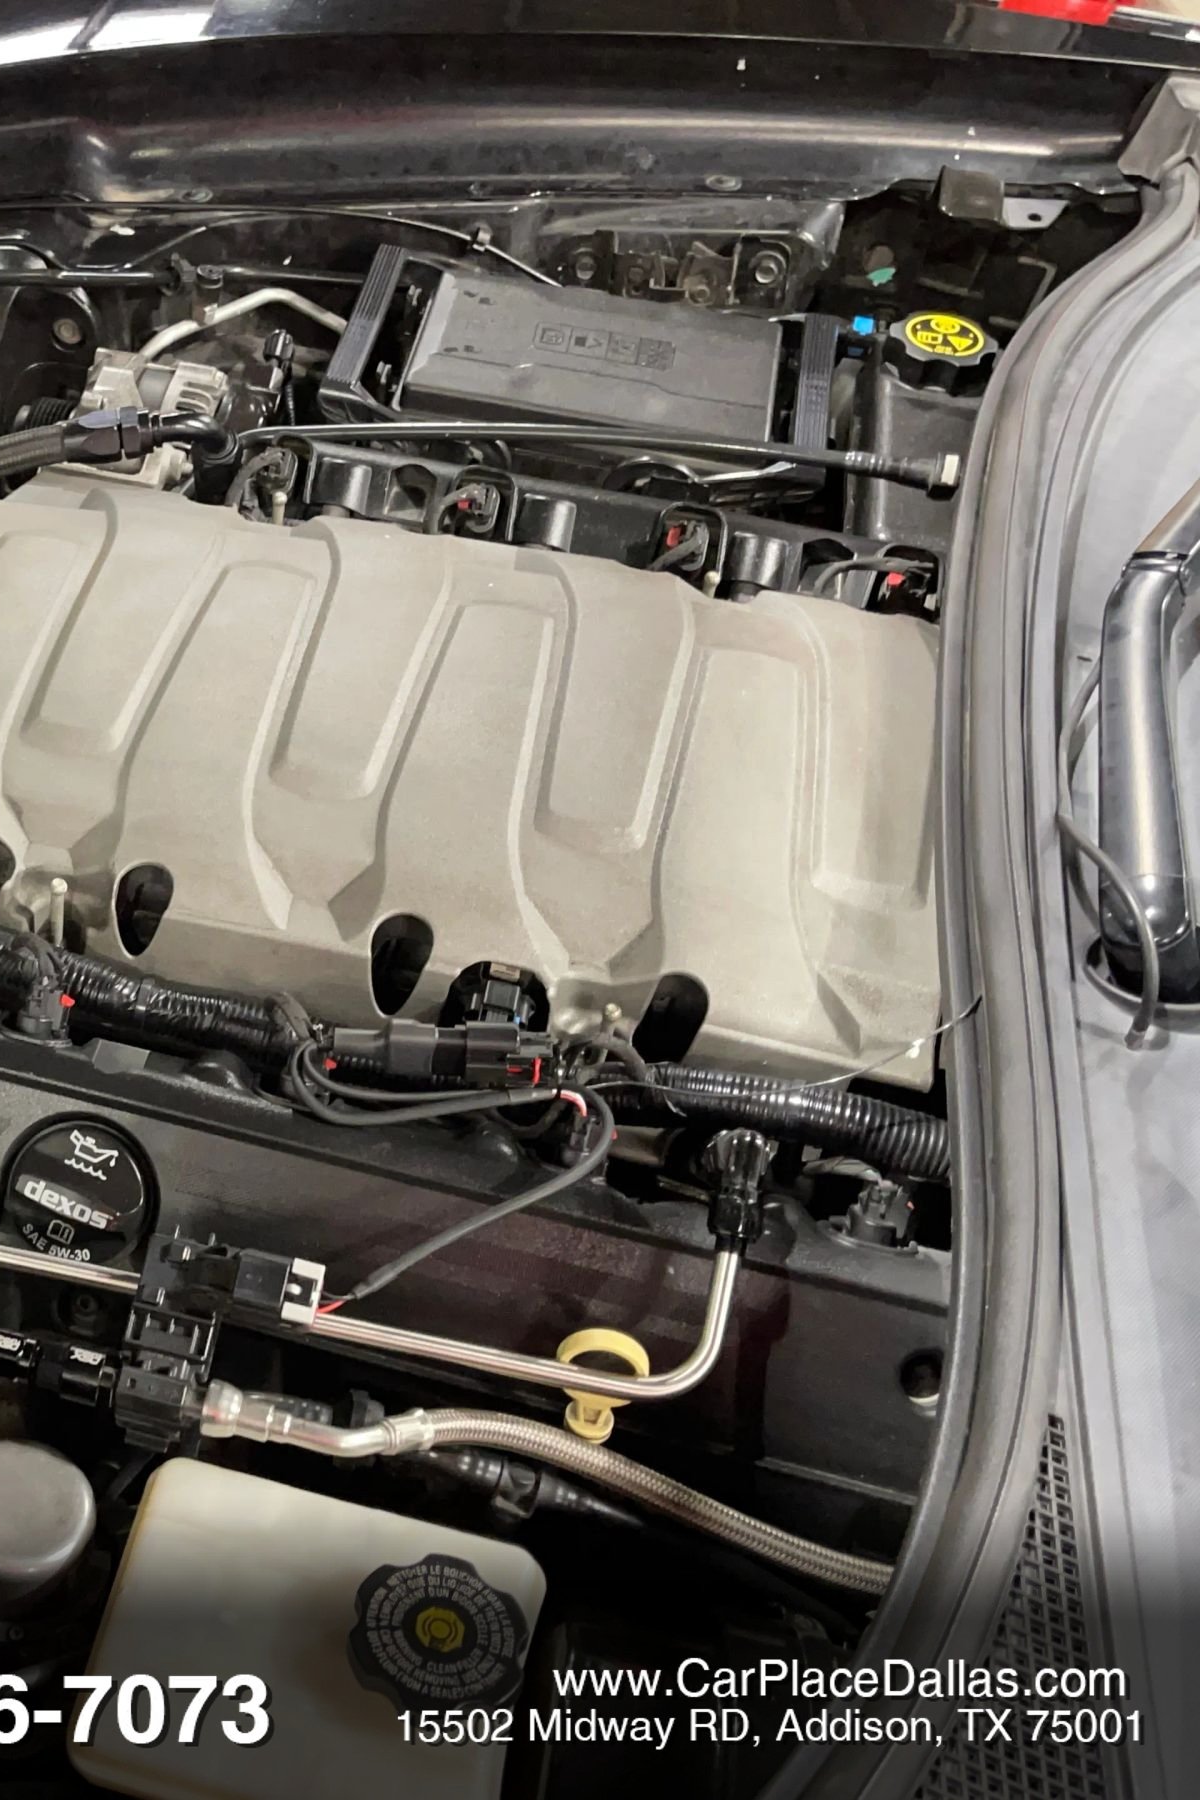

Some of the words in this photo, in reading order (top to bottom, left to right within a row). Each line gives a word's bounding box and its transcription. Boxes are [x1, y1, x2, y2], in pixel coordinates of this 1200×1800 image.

[23, 1180, 108, 1230] dexos
[22, 1223, 48, 1251] SAE
[48, 1245, 91, 1261] 5W-30
[430, 1566, 440, 1575] LE
